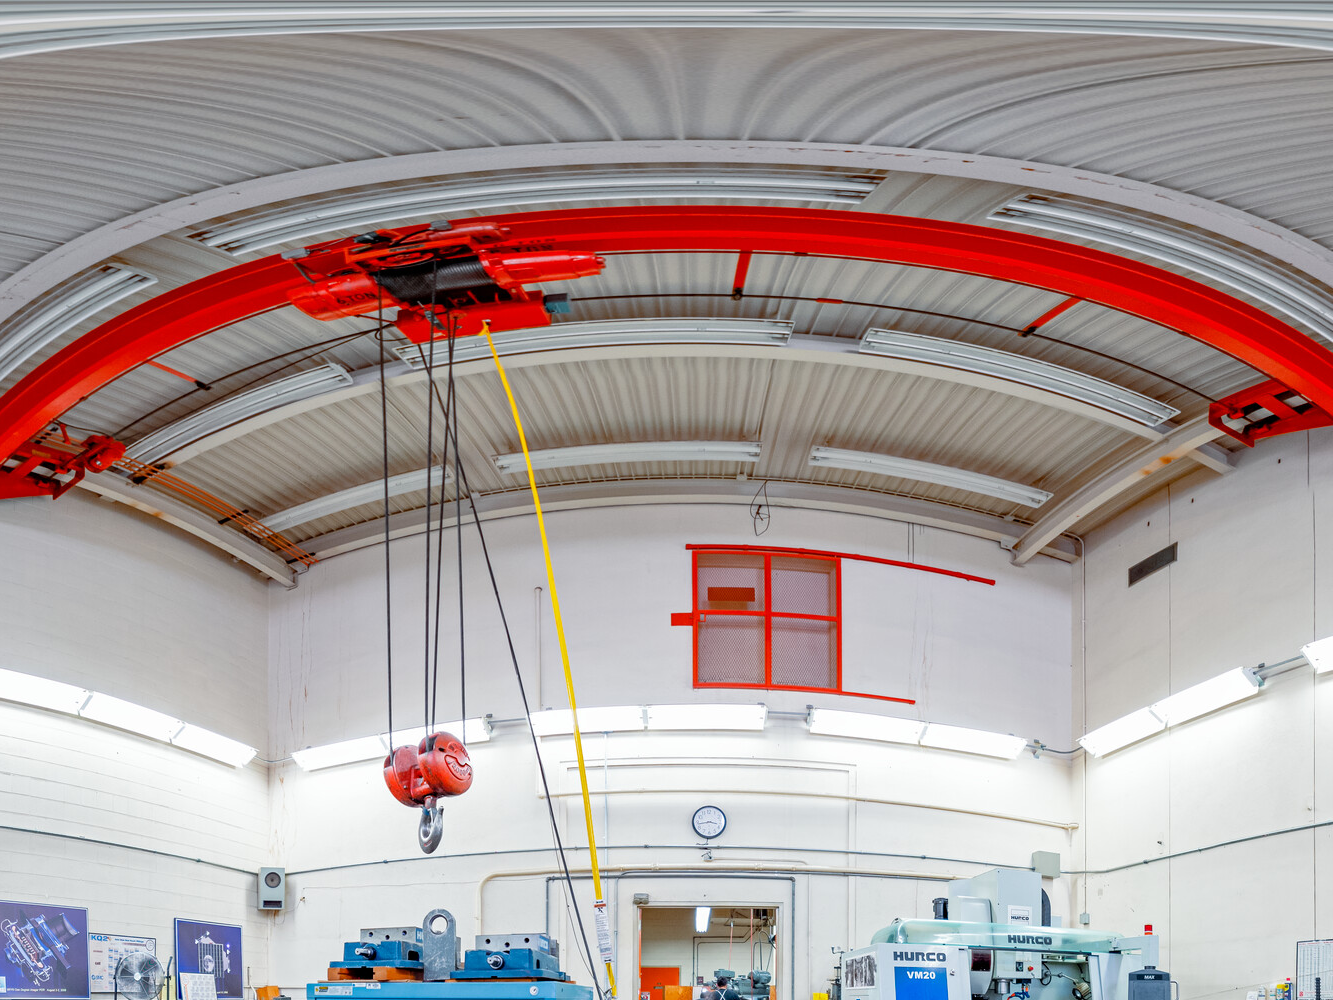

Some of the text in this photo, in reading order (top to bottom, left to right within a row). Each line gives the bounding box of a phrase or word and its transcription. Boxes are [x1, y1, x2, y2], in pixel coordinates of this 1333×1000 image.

[91, 934, 108, 942] KQ2
[1007, 934, 1053, 945] HURCO
[893, 951, 947, 962] HURCO
[907, 970, 936, 980] VM20
